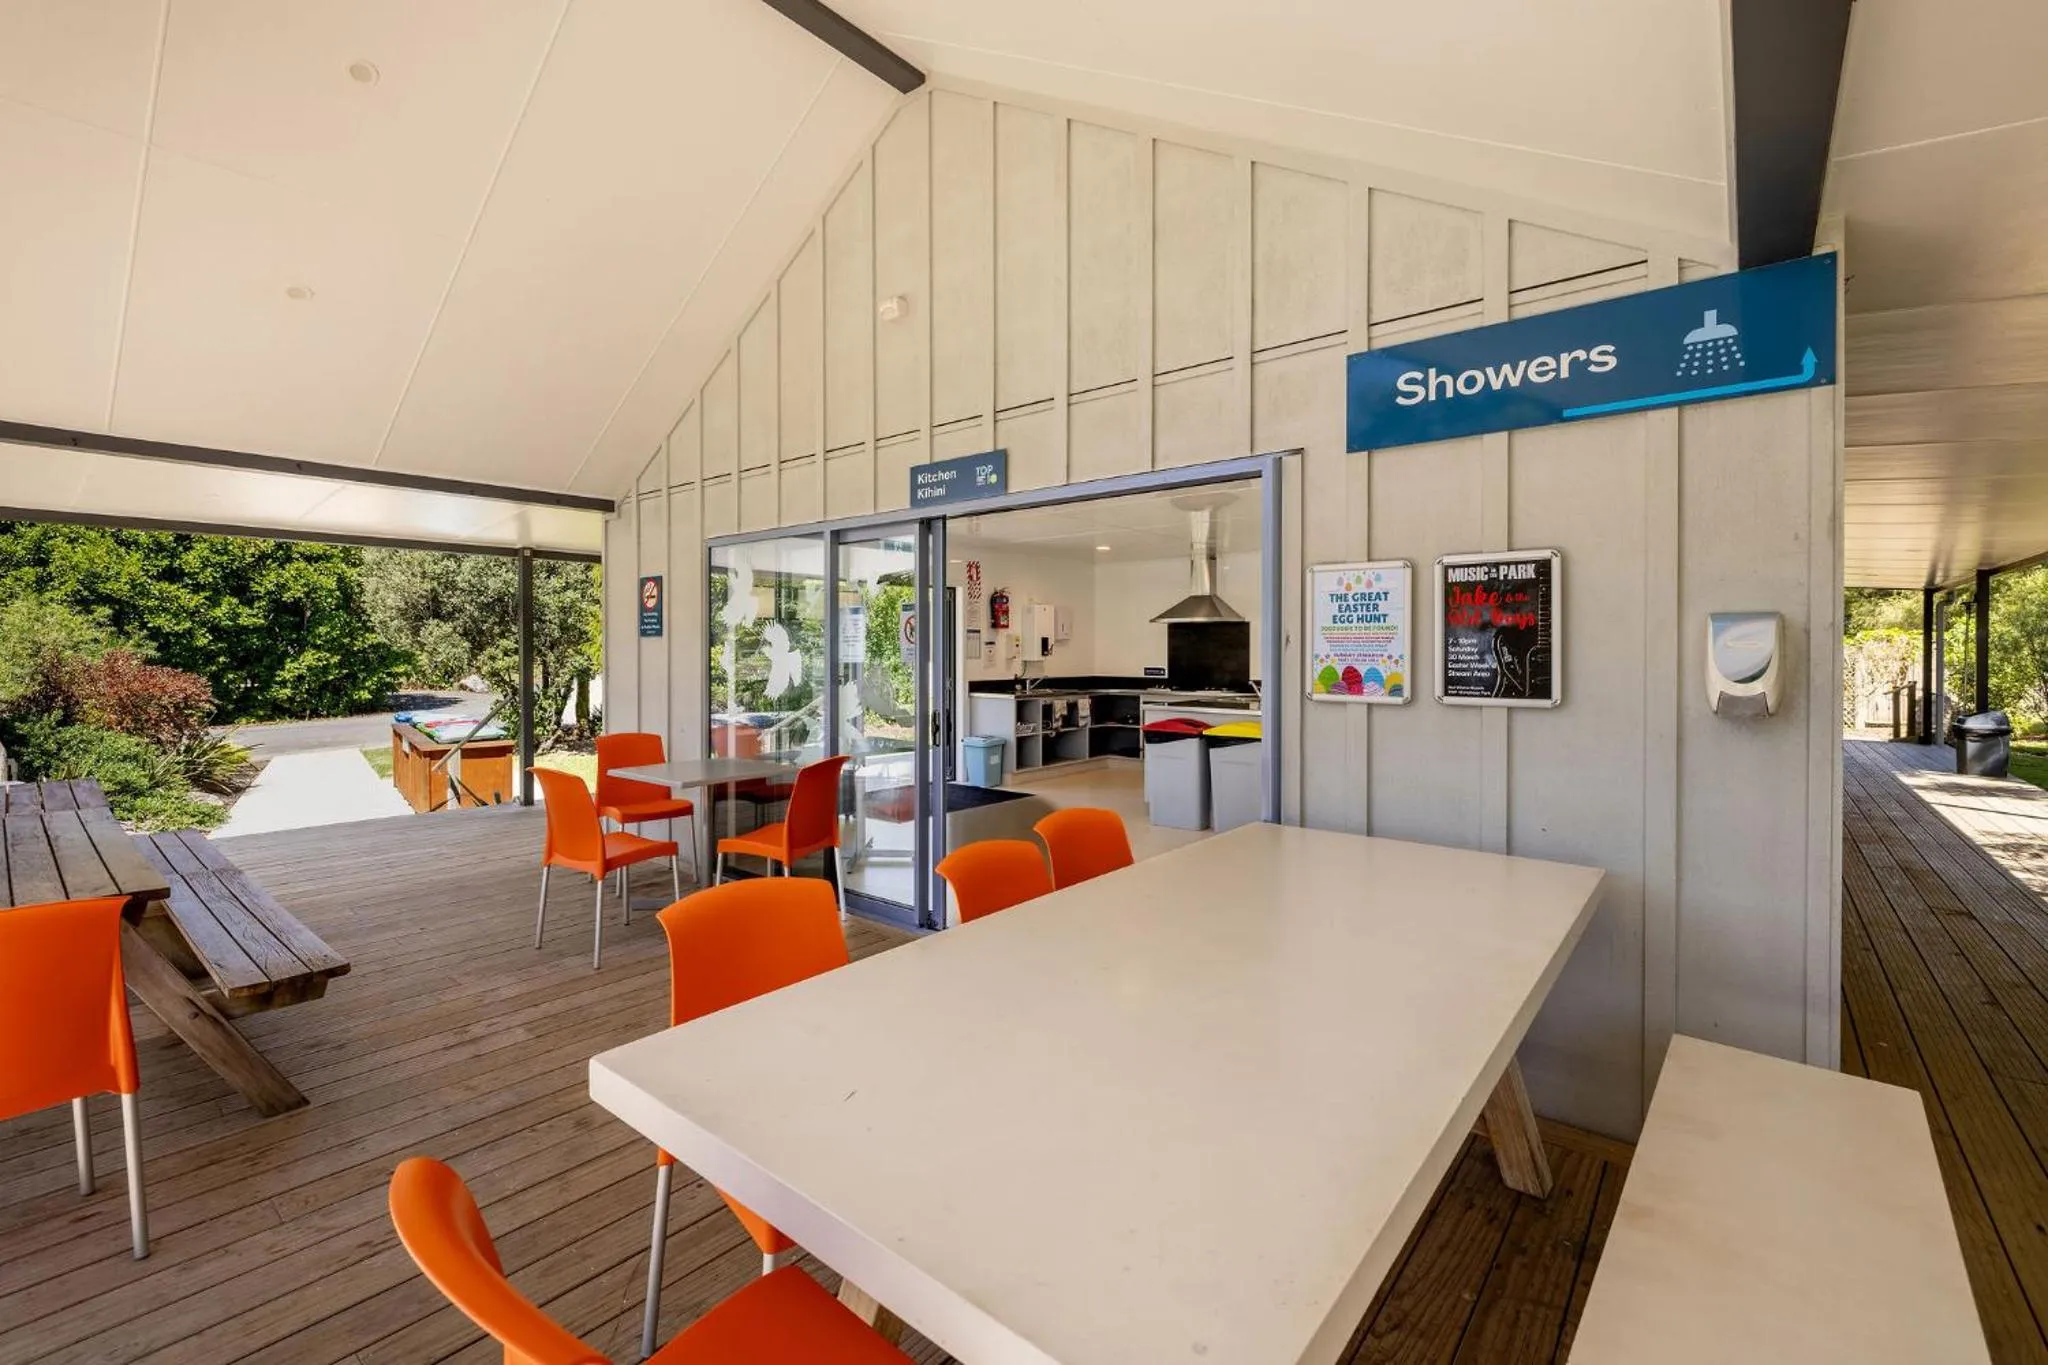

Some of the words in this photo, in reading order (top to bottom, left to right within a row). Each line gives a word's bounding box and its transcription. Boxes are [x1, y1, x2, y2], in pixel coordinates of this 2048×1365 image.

[1396, 344, 1617, 405] Showers
[917, 470, 957, 485] Kitchen
[1448, 566, 1488, 583] MUSIC
[1499, 564, 1536, 579] PARK
[1329, 593, 1350, 603] THE
[1352, 592, 1389, 602] GREAT
[1338, 603, 1379, 613] EASTER
[1332, 615, 1353, 624] EGG
[1357, 614, 1388, 623] HUNT
[1448, 646, 1478, 654] Saturday
